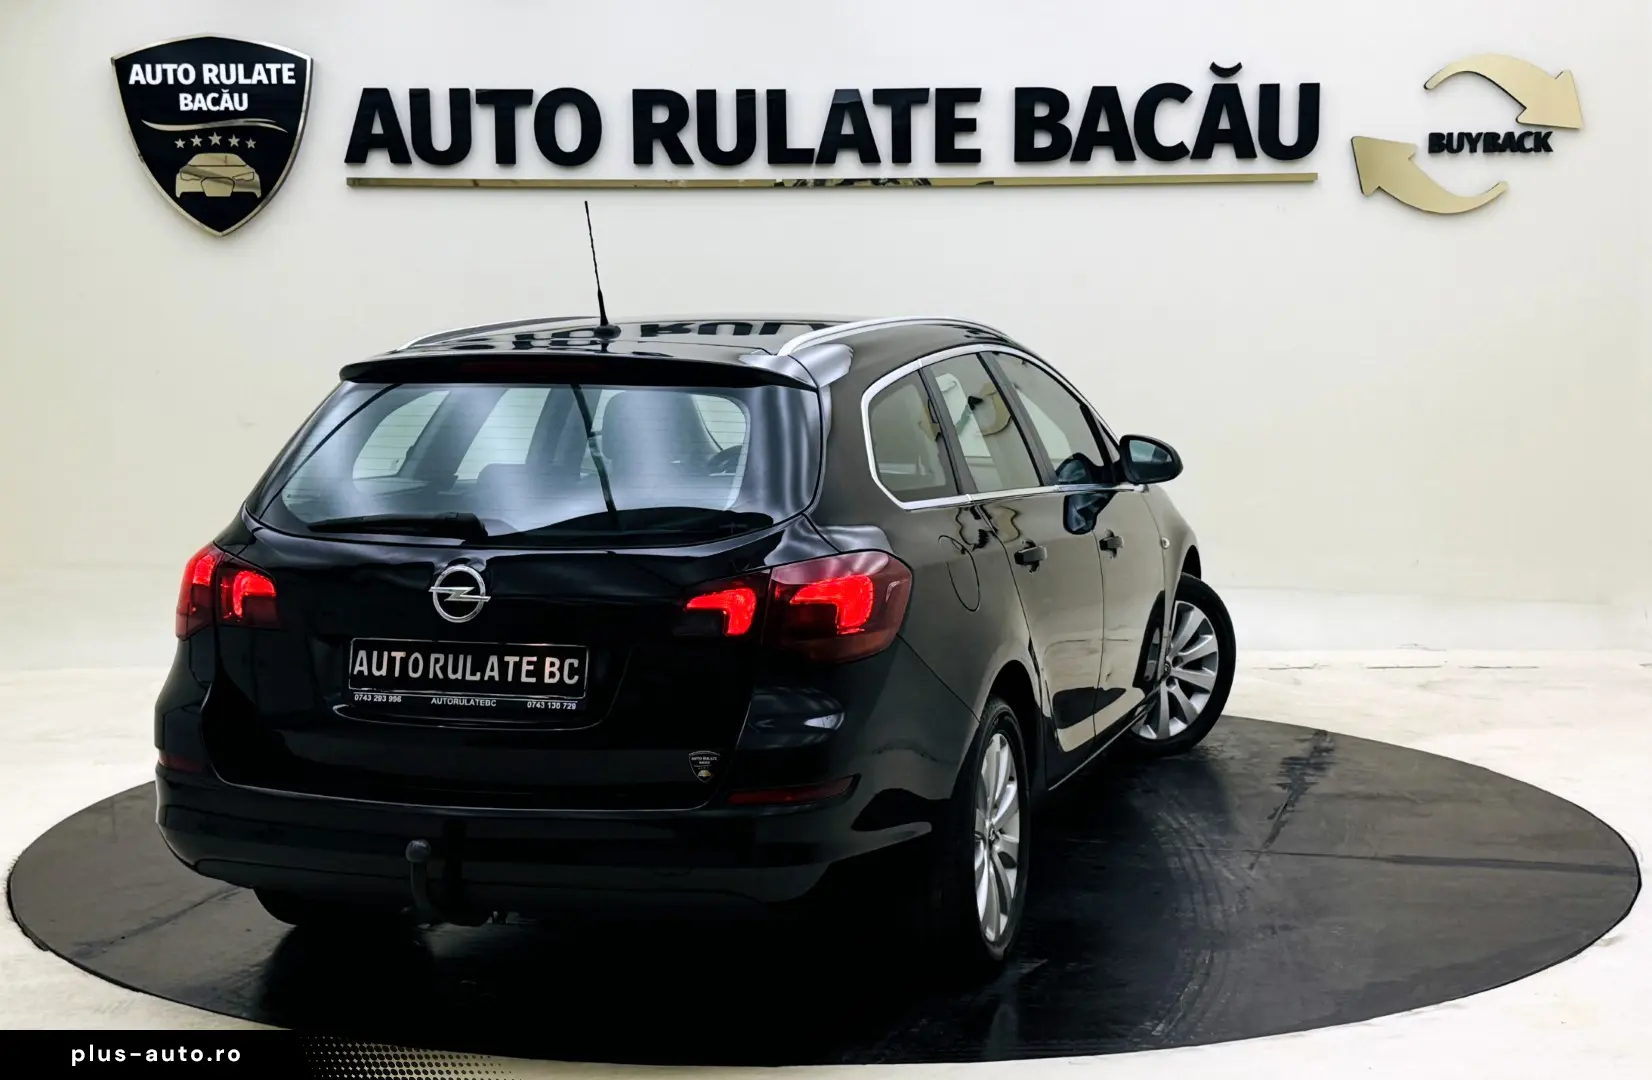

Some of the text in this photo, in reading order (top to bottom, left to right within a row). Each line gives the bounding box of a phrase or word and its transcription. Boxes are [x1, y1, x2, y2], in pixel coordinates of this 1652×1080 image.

[128, 63, 296, 85] AUTO RULATE
[178, 88, 249, 112] BACĂU
[344, 62, 1321, 169] AUTO RULATE BACĂU
[1428, 131, 1553, 154] BUYBACK
[543, 656, 579, 685] BC
[430, 697, 497, 707] AUTORULATEBC
